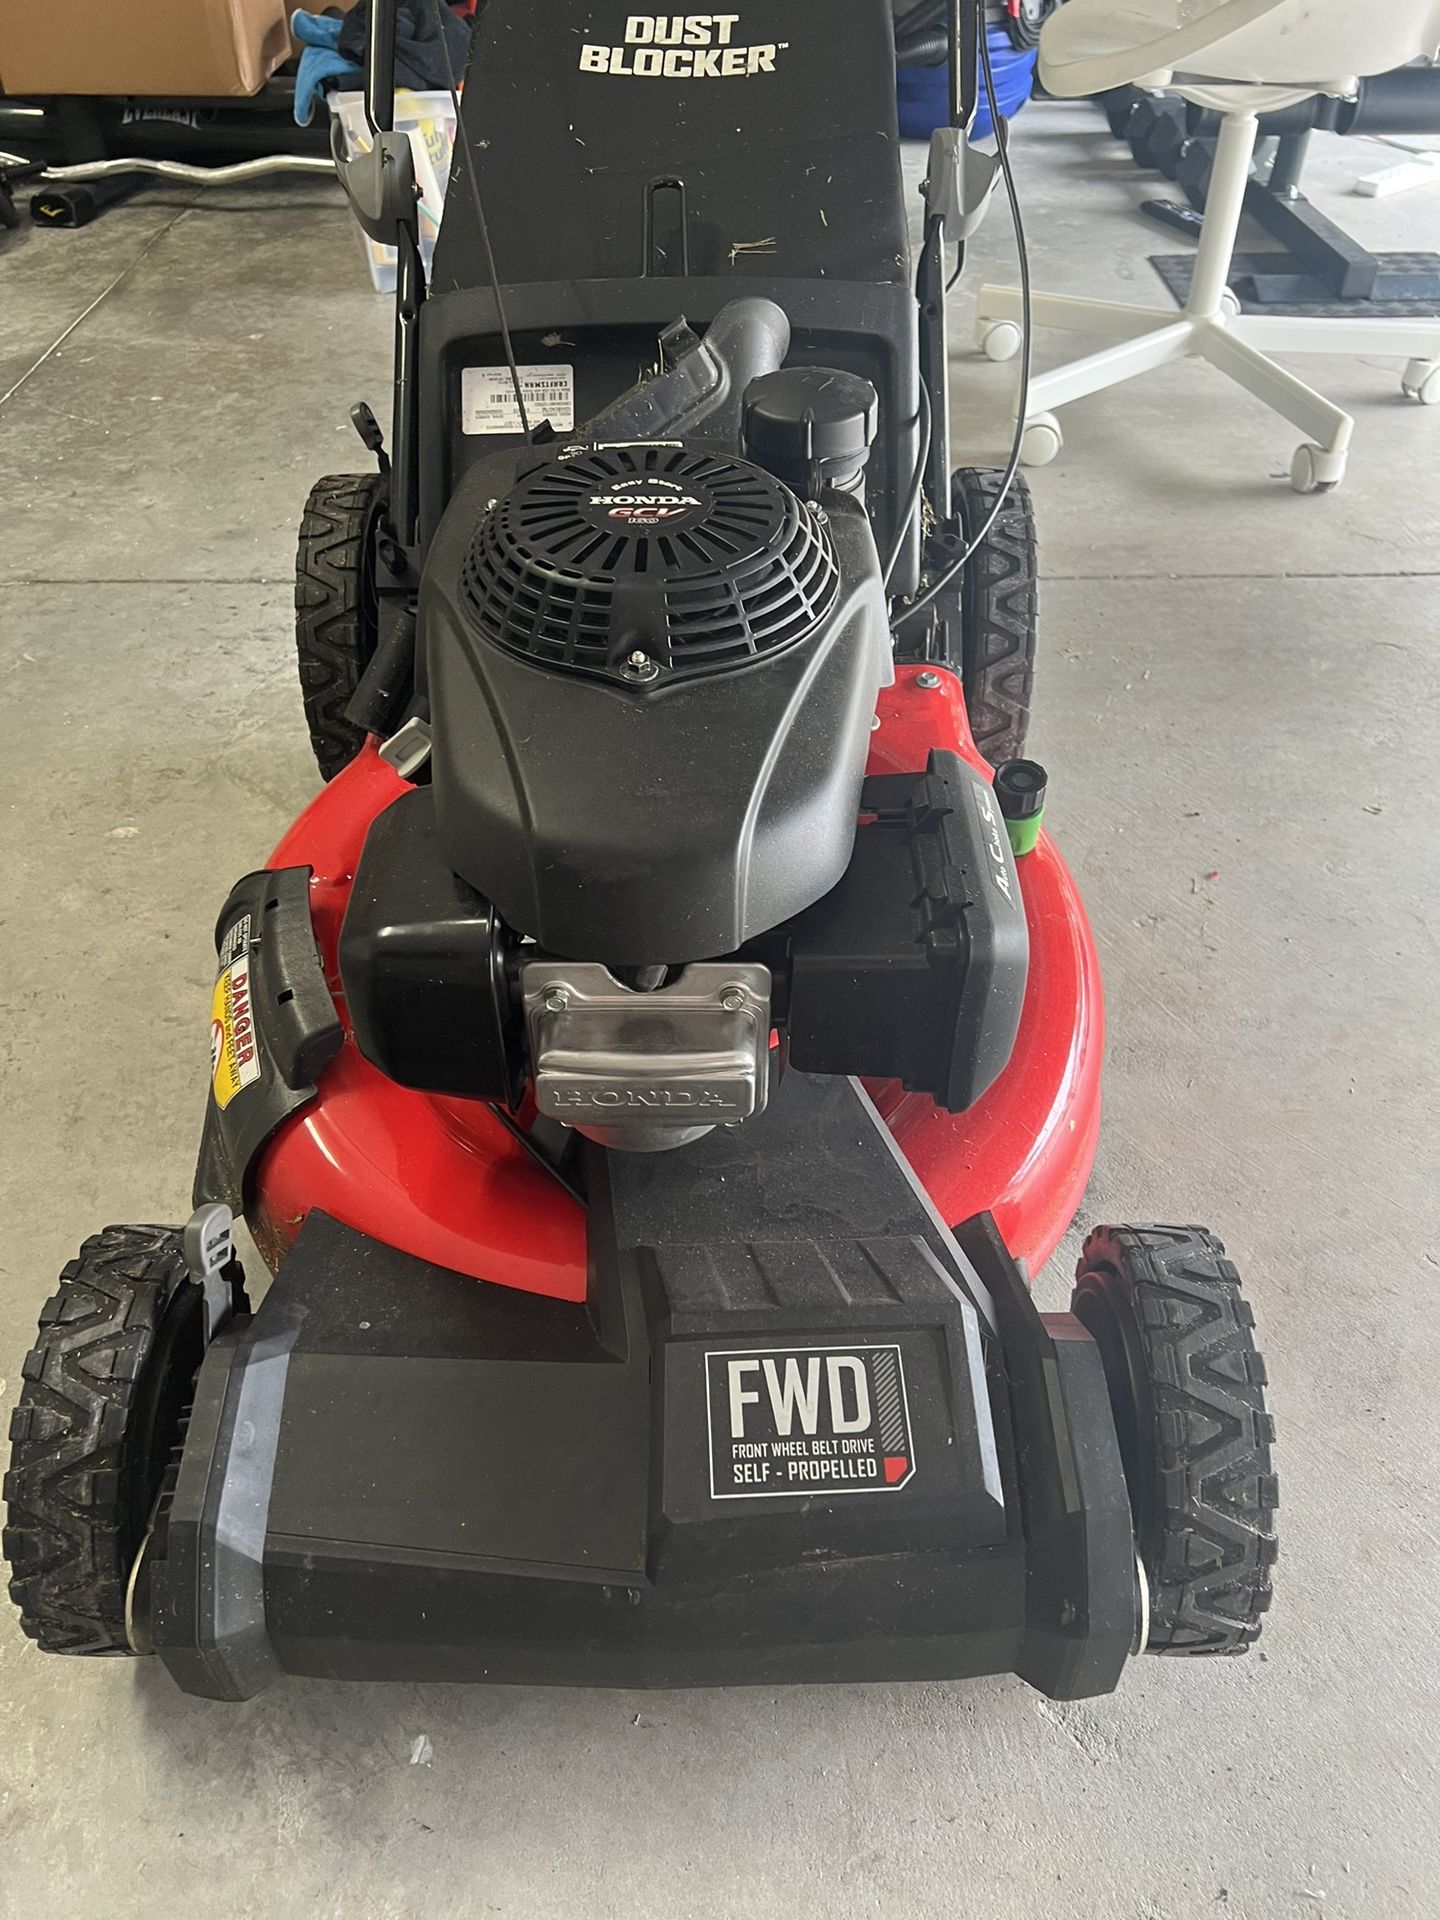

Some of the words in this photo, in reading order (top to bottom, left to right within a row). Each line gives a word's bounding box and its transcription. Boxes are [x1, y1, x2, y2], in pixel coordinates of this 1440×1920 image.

[624, 14, 740, 45] DUST
[524, 380, 568, 389] CRAFTSMAN
[589, 495, 702, 505] HONDA
[607, 507, 689, 518] GCV
[223, 973, 231, 994] KEEP
[223, 994, 232, 1024] HANDS
[231, 972, 254, 1068] DANGER
[226, 1039, 236, 1061] FEET
[228, 1062, 239, 1088] AWAY
[553, 1090, 737, 1107] HONDA
[727, 1355, 872, 1438] FWD
[732, 1443, 768, 1459] FRONT
[771, 1441, 809, 1457] WHEEL
[812, 1440, 839, 1455] BELT
[841, 1438, 875, 1454] DRIVE
[733, 1462, 771, 1484] SELF
[788, 1458, 878, 1481] PROPELLED
